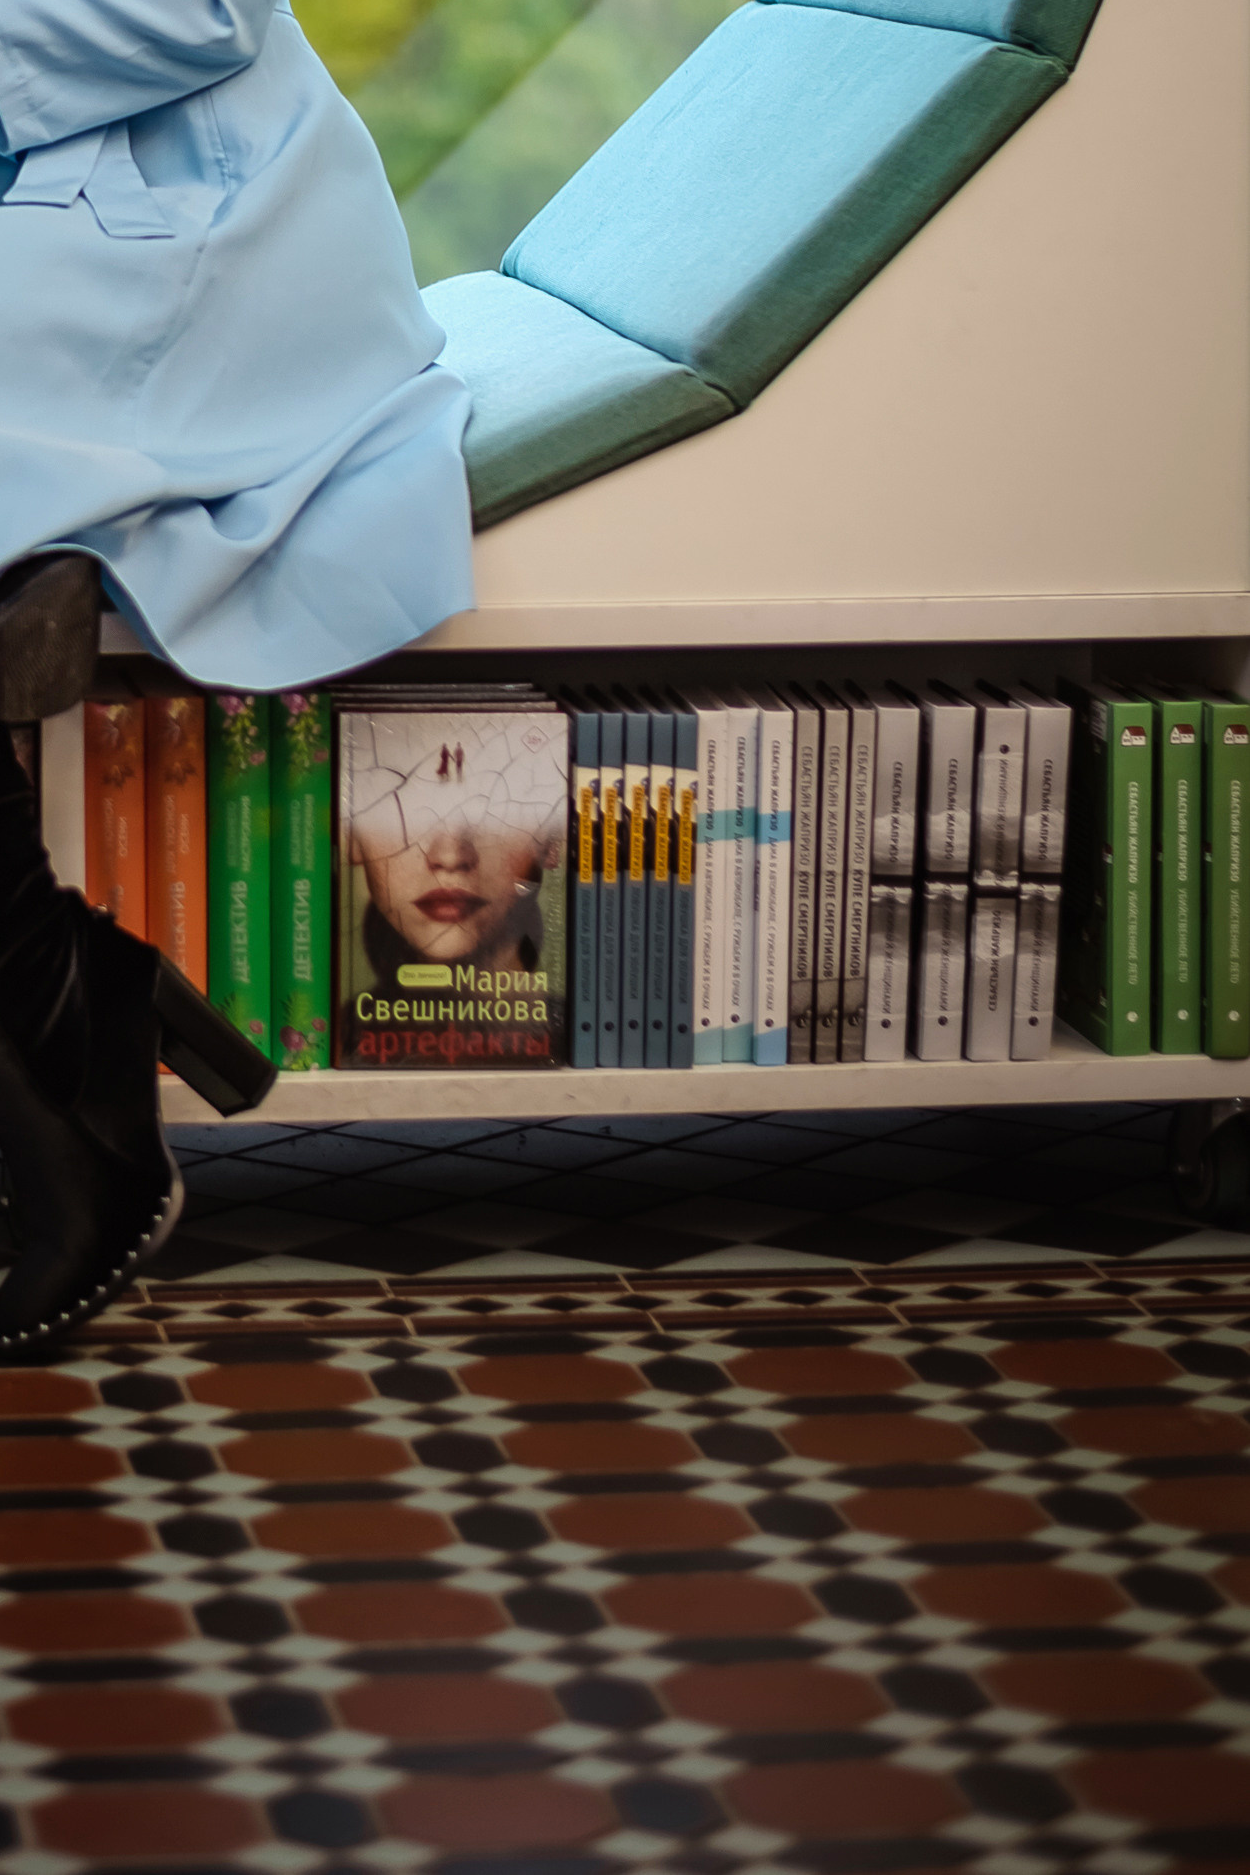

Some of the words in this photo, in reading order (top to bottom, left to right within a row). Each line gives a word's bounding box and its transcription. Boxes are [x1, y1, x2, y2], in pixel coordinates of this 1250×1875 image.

[707, 739, 716, 786] СЕБАСТЬЯН
[737, 736, 746, 784] СЕБАСТЬЯН
[771, 740, 781, 788] СЕБАСТЬЯН
[800, 746, 813, 808] СЕБАСТЬЯН
[828, 745, 841, 807] СЕБАСТЬЯН
[856, 744, 869, 806] СЕБАСТЬЯН
[947, 758, 958, 811] СЕБАСТЬЯН
[1042, 758, 1053, 812] СЕБАСТЬЯН
[706, 788, 715, 831] ЖАПРИЗО
[736, 784, 745, 828] ЖАПРИЗО
[770, 788, 779, 832] ЖАПРИЗО
[891, 760, 903, 814] СЕБАСТЬЯН
[997, 758, 1008, 822] ЖЕНЩИНАМИ
[1128, 781, 1139, 835] СЕБАСТЬЯН
[1177, 779, 1188, 833] СЕБАСТЬЯН
[1230, 780, 1241, 833] СЕБАСТЬЯН
[704, 835, 715, 860] ДАМА
[734, 832, 744, 857] ДАМА
[768, 836, 778, 862] ДАМА
[799, 810, 811, 866] ЖАПРИЗО
[826, 809, 838, 865] ЖАПРИЗО
[854, 808, 866, 865] ЖАПРИЗО
[890, 815, 900, 863] ЖАПРИЗО
[944, 812, 955, 860] ЖАПРИЗО
[1038, 813, 1049, 861] ЖАПРИЗО
[1128, 835, 1139, 884] ЖАПРИЗО
[1177, 833, 1188, 882] ЖАПРИЗО
[1230, 834, 1241, 882] ЖАПРИЗО
[798, 870, 810, 900] КУПЕ
[825, 870, 837, 899] КУПЕ
[852, 869, 864, 898] КУПЕ
[230, 880, 250, 984] ДЕТЕКТИВ
[293, 879, 313, 982] ДЕТЕКТИВ
[797, 903, 809, 978] СМЕРТНИКОВ
[823, 902, 836, 978] СМЕРТНИКОВ
[850, 901, 863, 977] СМЕРТНИКОВ
[990, 910, 1001, 957] ЖАПРИЗО
[1128, 890, 1139, 960] УБИЙСТВЕННОЕ
[1178, 888, 1189, 958] УБИЙСТВЕННОЕ
[1230, 888, 1241, 959] УБИЙСТВЕННОЕ
[456, 964, 548, 999] Мария
[882, 951, 894, 1014] ЖЕНЩИНАМИ
[939, 947, 951, 1012] ЖЕНЩИНАМИ
[988, 959, 1000, 1012] СЕБАСТЬЯН
[1030, 948, 1042, 1012] ЖЕНЩИНАМИ
[1128, 962, 1139, 985] ЛЕТО
[1178, 959, 1189, 983] ЛЕТО
[1230, 960, 1240, 984] ЛЕТО
[356, 992, 548, 1021] Свешникова
[358, 1022, 550, 1064] артефакты
